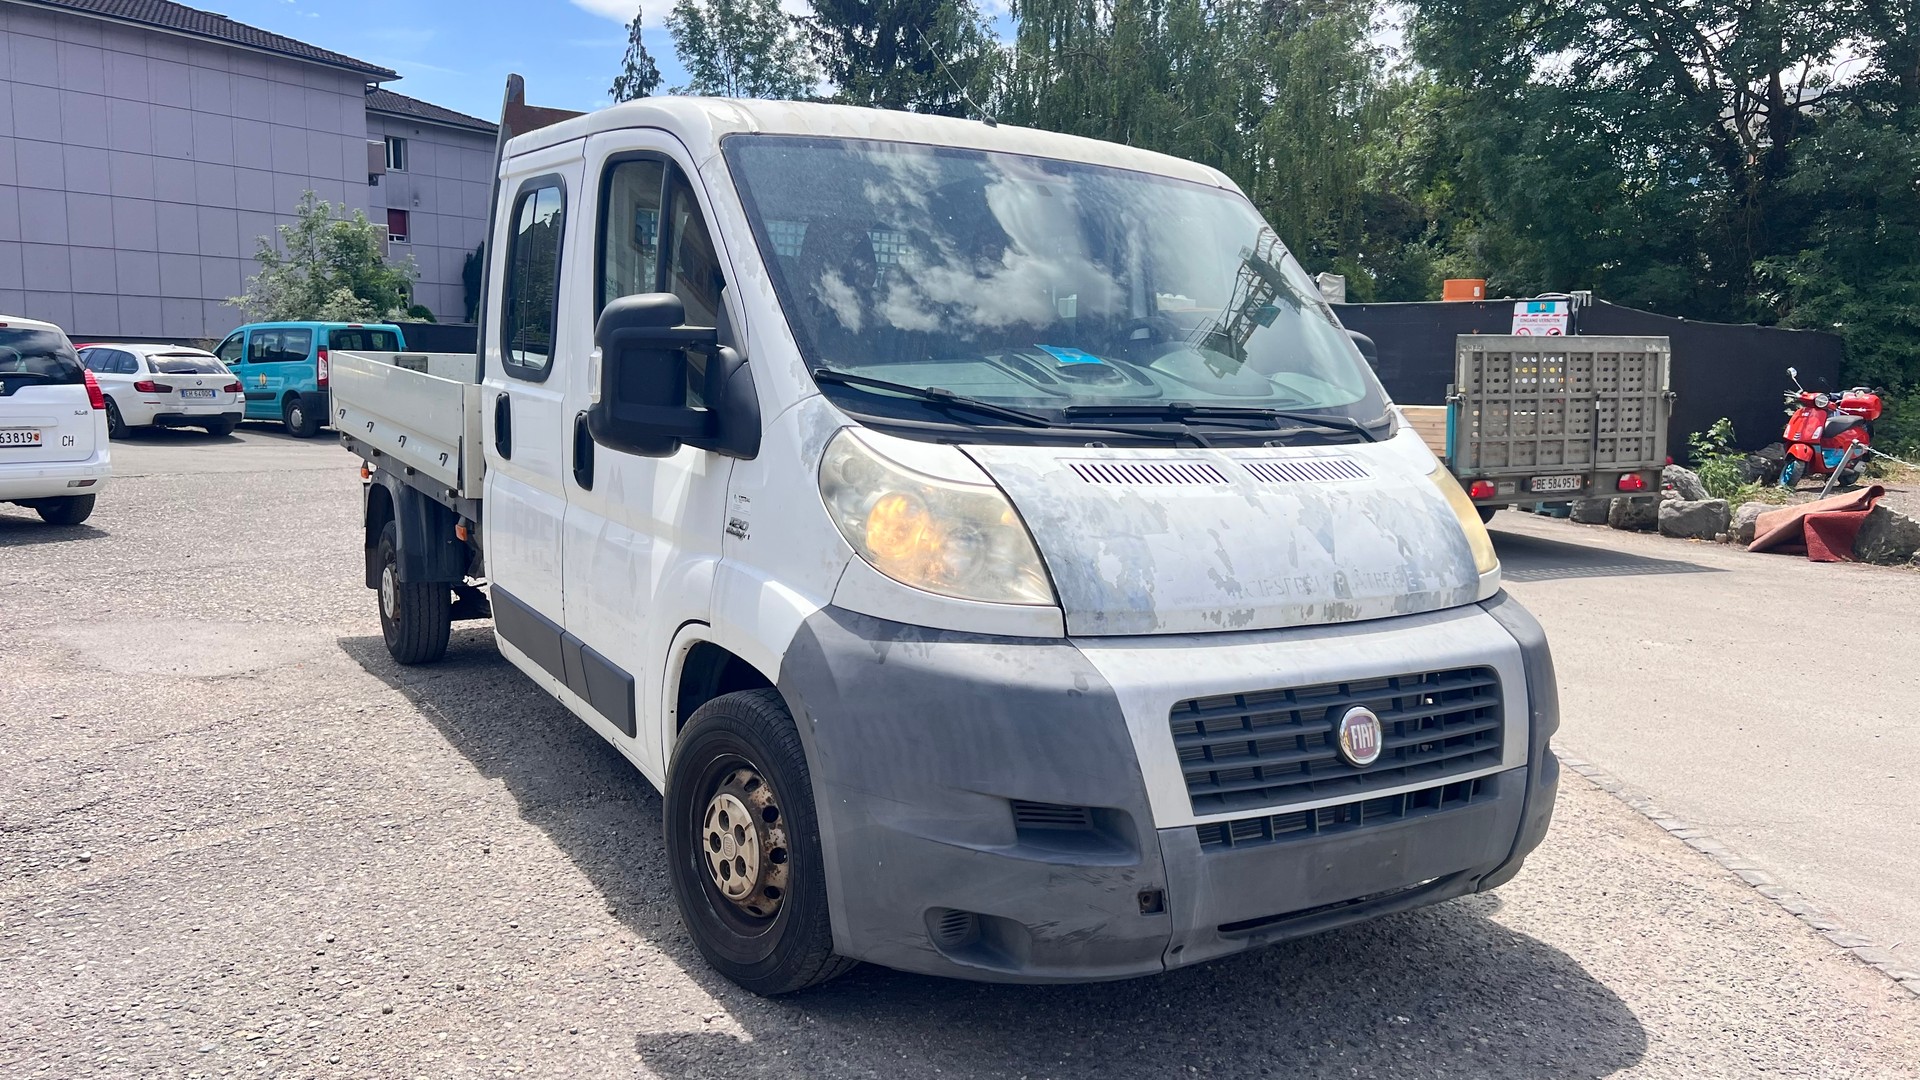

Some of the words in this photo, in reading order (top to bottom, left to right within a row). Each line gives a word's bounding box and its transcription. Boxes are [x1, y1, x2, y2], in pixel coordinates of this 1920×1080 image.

[62, 435, 75, 447] CH
[1536, 479, 1545, 490] BE
[1548, 477, 1575, 489] 584951
[1350, 722, 1374, 750] FIAT
